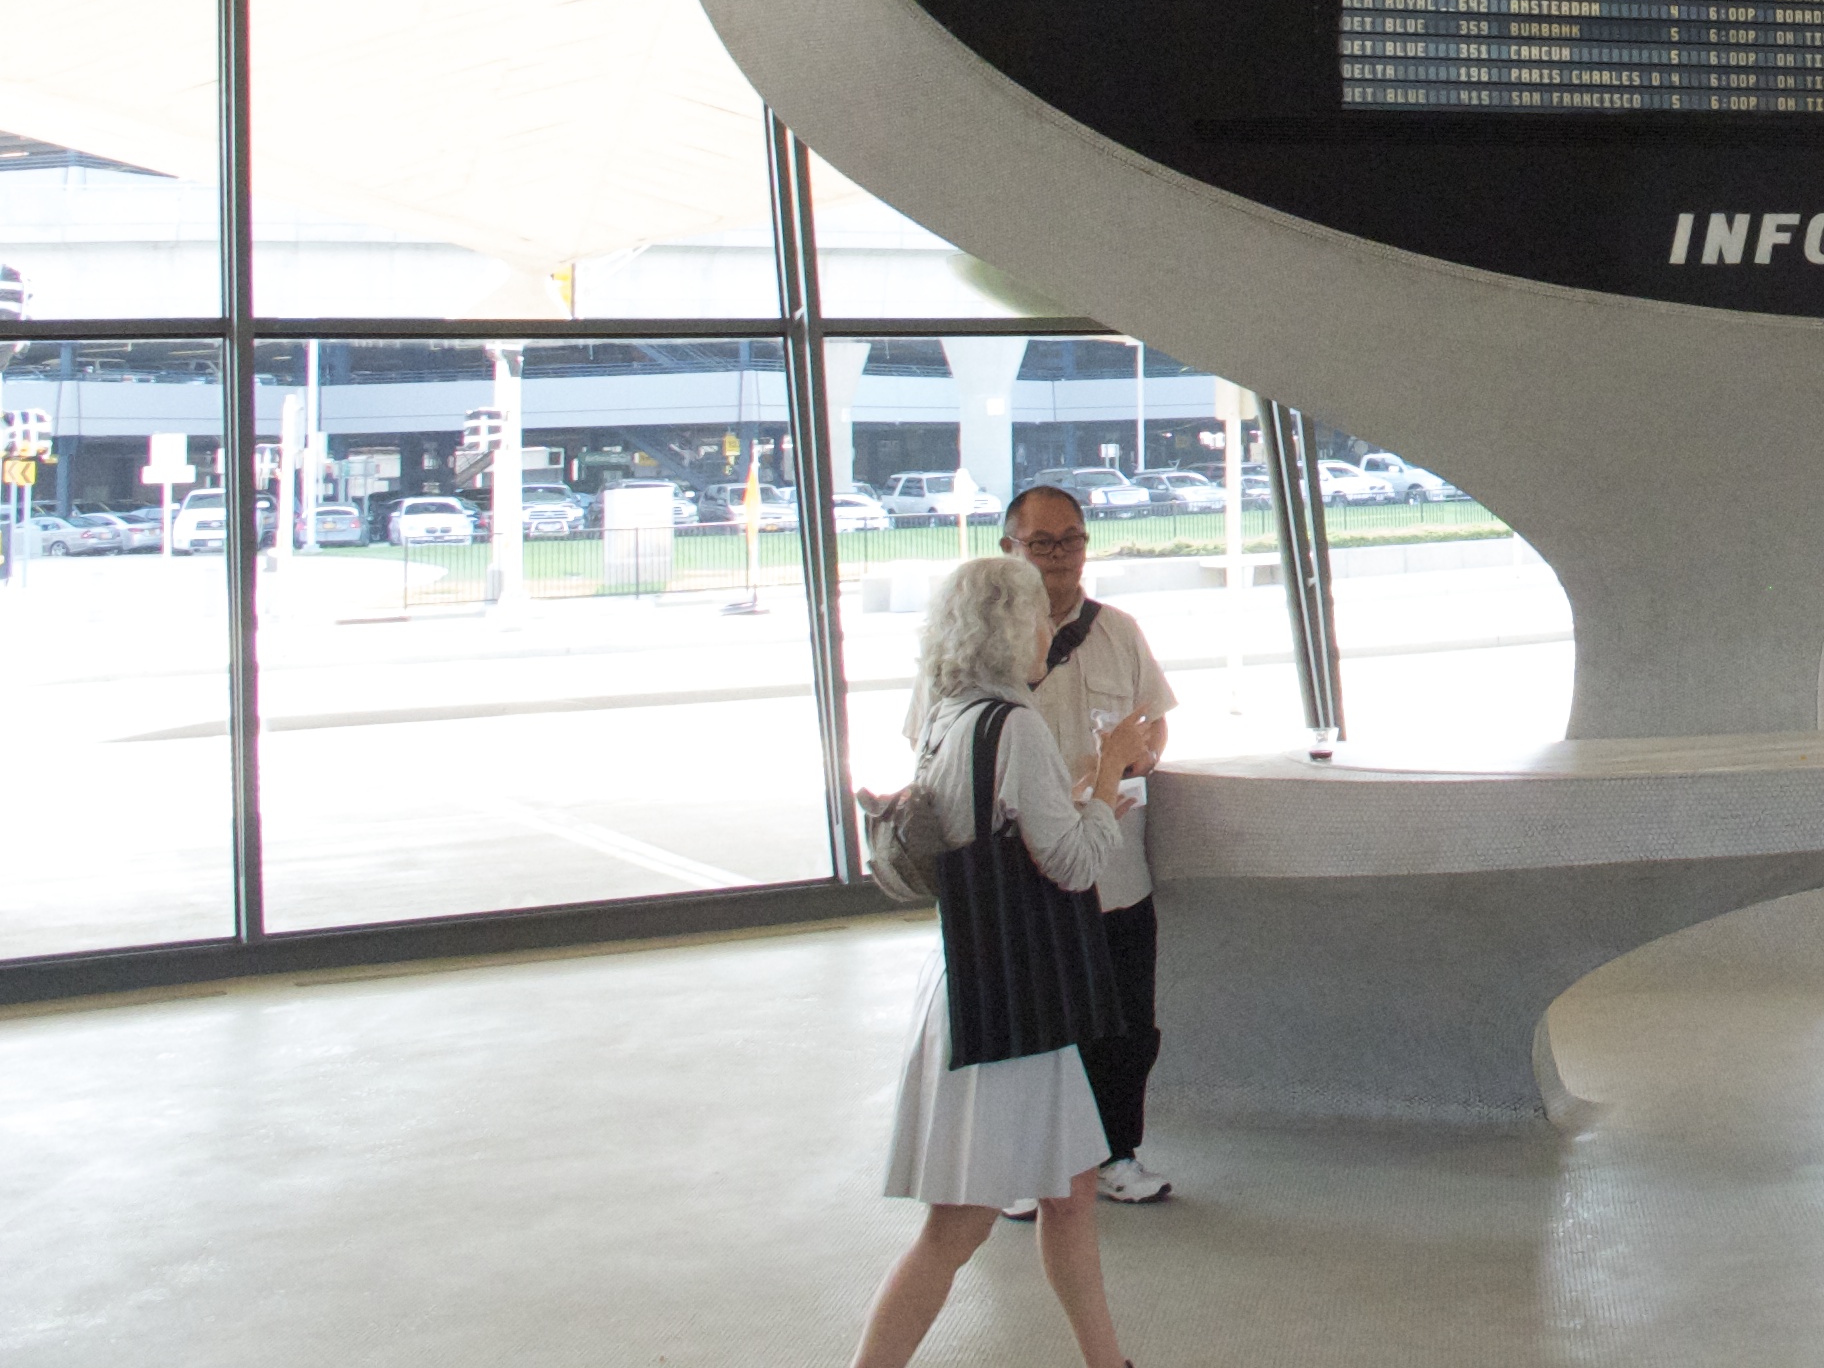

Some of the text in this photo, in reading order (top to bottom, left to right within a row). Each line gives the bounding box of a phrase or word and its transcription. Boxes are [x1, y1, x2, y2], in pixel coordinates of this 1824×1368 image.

[1342, 14, 1374, 31] JET
[1385, 16, 1427, 33] BLUE
[1459, 19, 1490, 35] 359
[1510, 21, 1581, 38] BURBANK
[1776, 30, 1795, 44] ON
[1343, 38, 1374, 54] JET
[1385, 40, 1427, 56] BLUE
[1459, 42, 1490, 58] 351
[1511, 44, 1572, 60] CANCUN
[1777, 52, 1795, 66] ON
[1343, 62, 1396, 78] DELTA
[1511, 67, 1562, 83] PARIS
[1572, 69, 1642, 85] CHARLES
[1777, 74, 1796, 88] ON
[1343, 85, 1375, 101] JET
[1386, 86, 1428, 102] BLUE
[1512, 90, 1542, 105] SAN
[1552, 91, 1642, 108] FRANCISCO
[1778, 96, 1796, 110] ON
